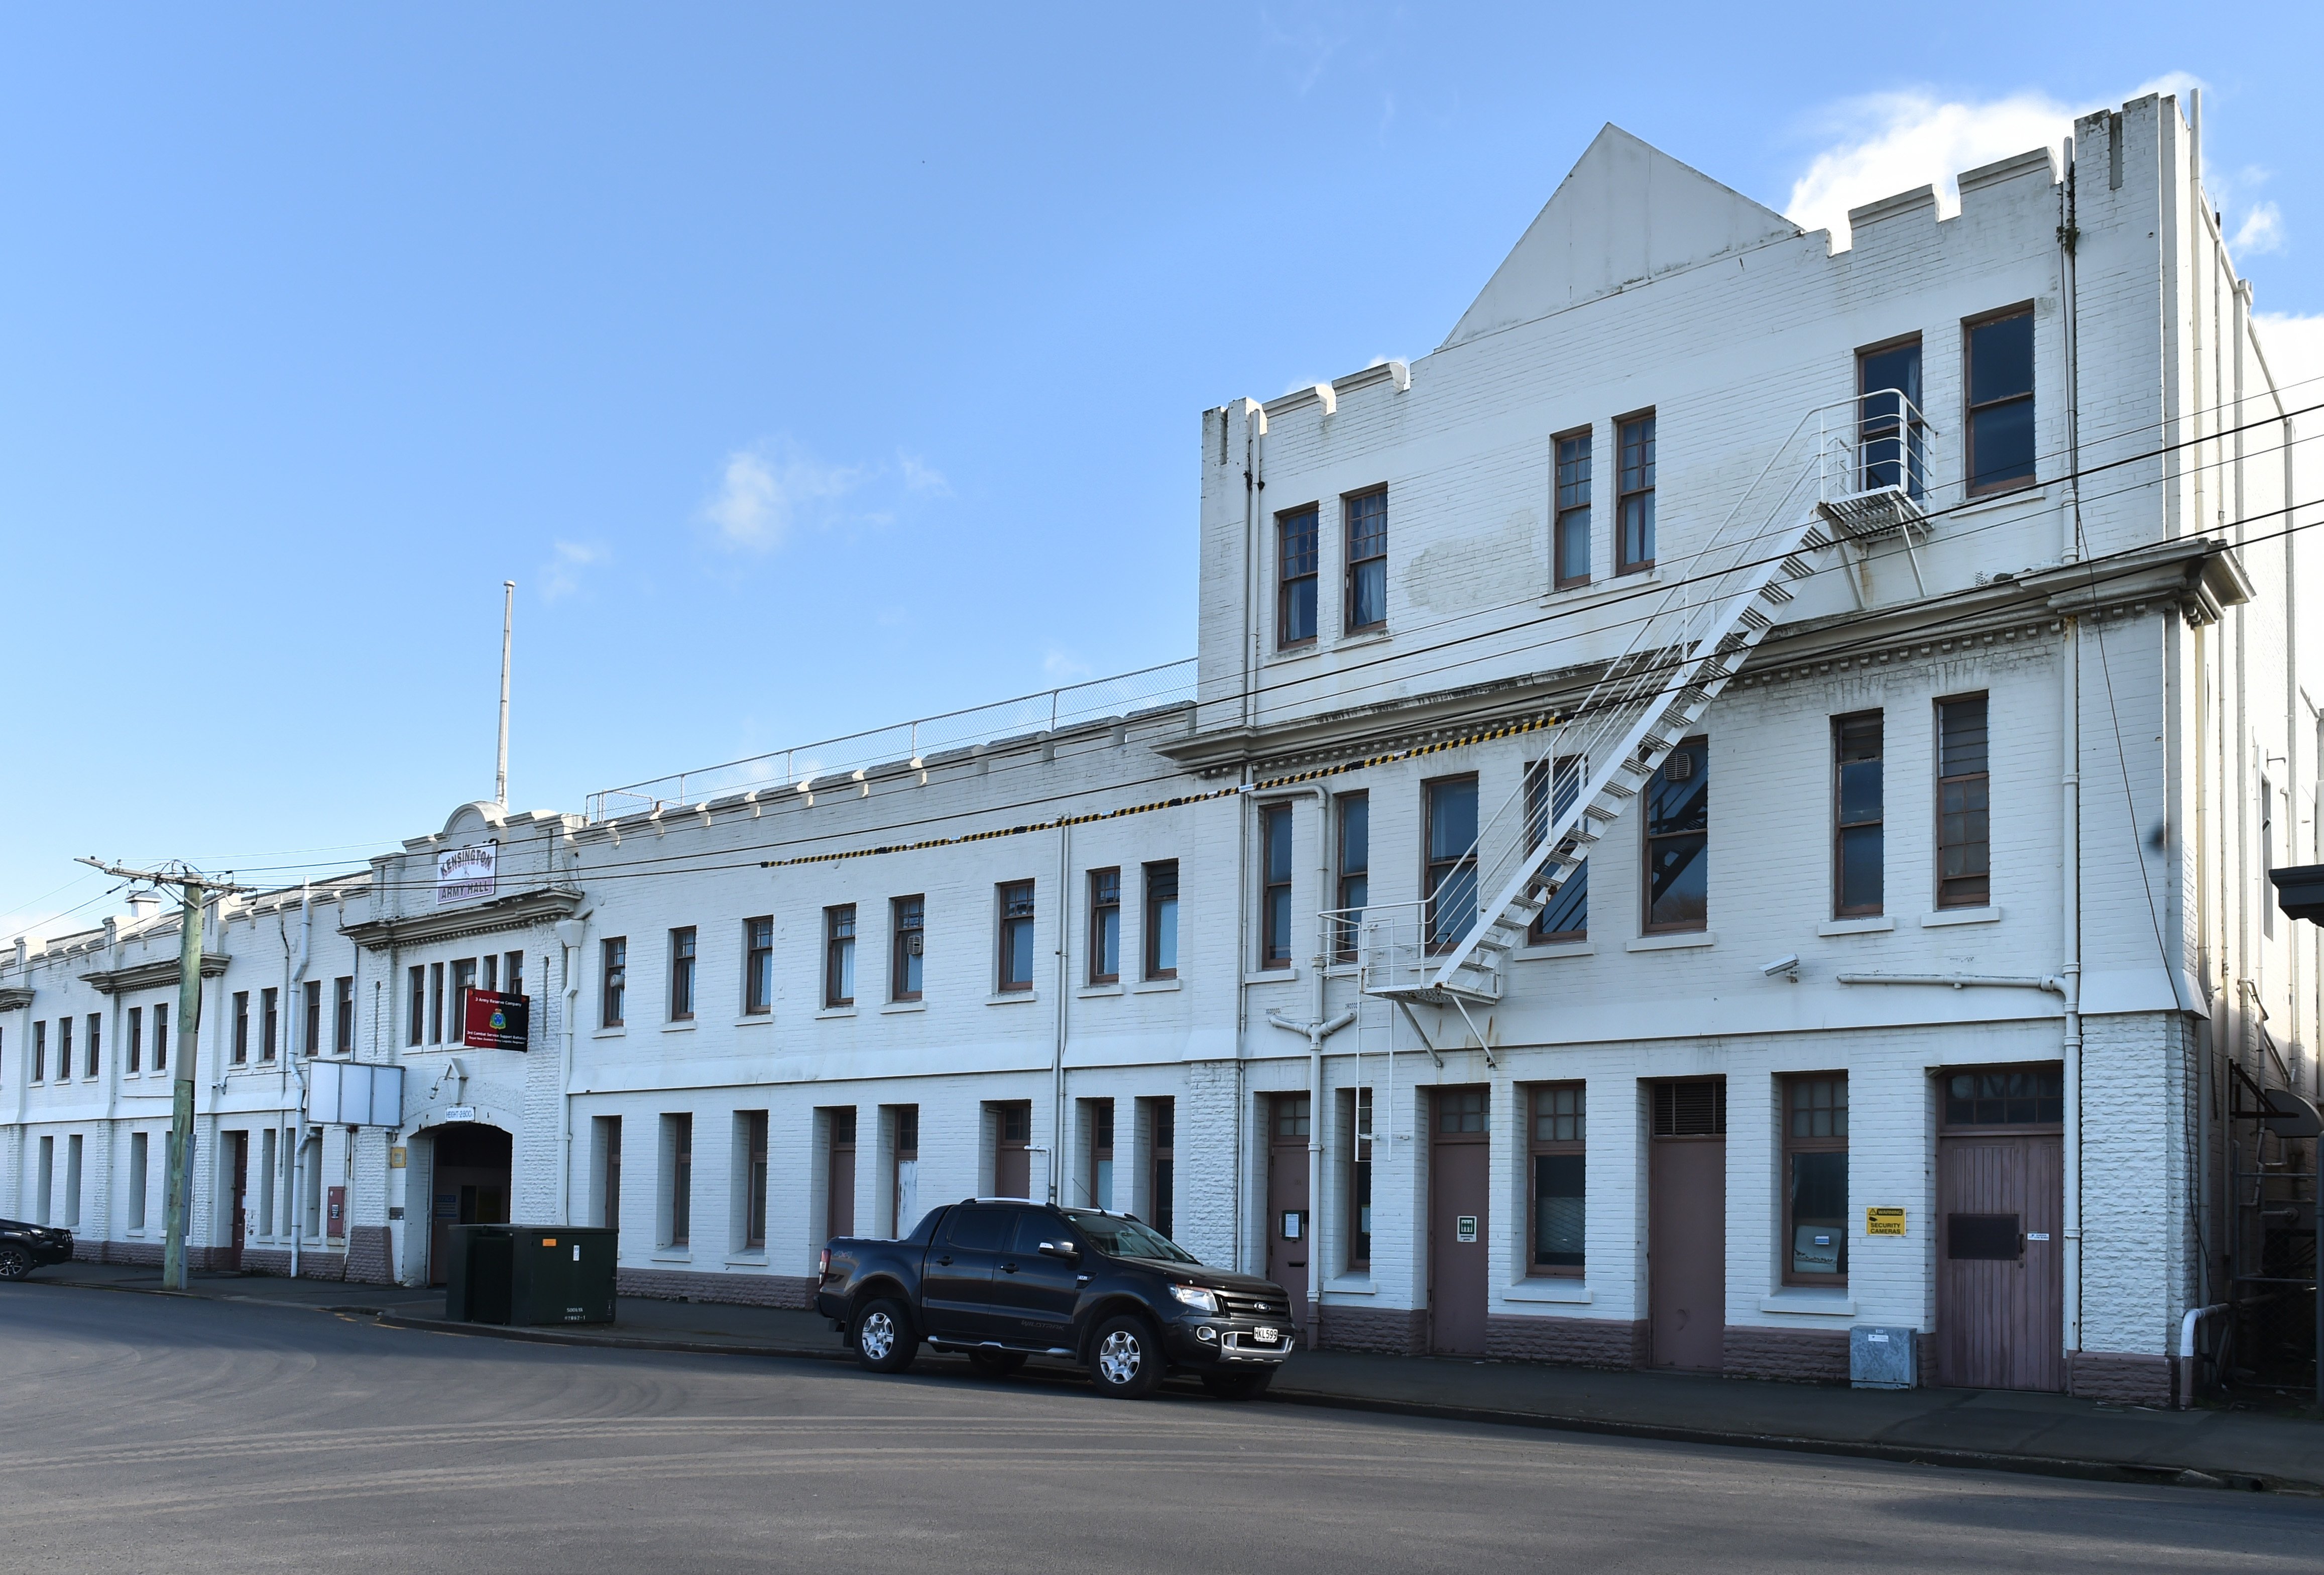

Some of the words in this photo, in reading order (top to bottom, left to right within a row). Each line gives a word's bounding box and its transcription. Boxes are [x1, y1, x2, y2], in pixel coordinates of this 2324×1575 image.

[440, 849, 493, 877] KENSINGTON
[441, 885, 464, 899] ARMY
[468, 880, 489, 895] HALL
[1021, 1319, 1065, 1331] WILDTRAK
[1254, 1329, 1277, 1340] HKL599
